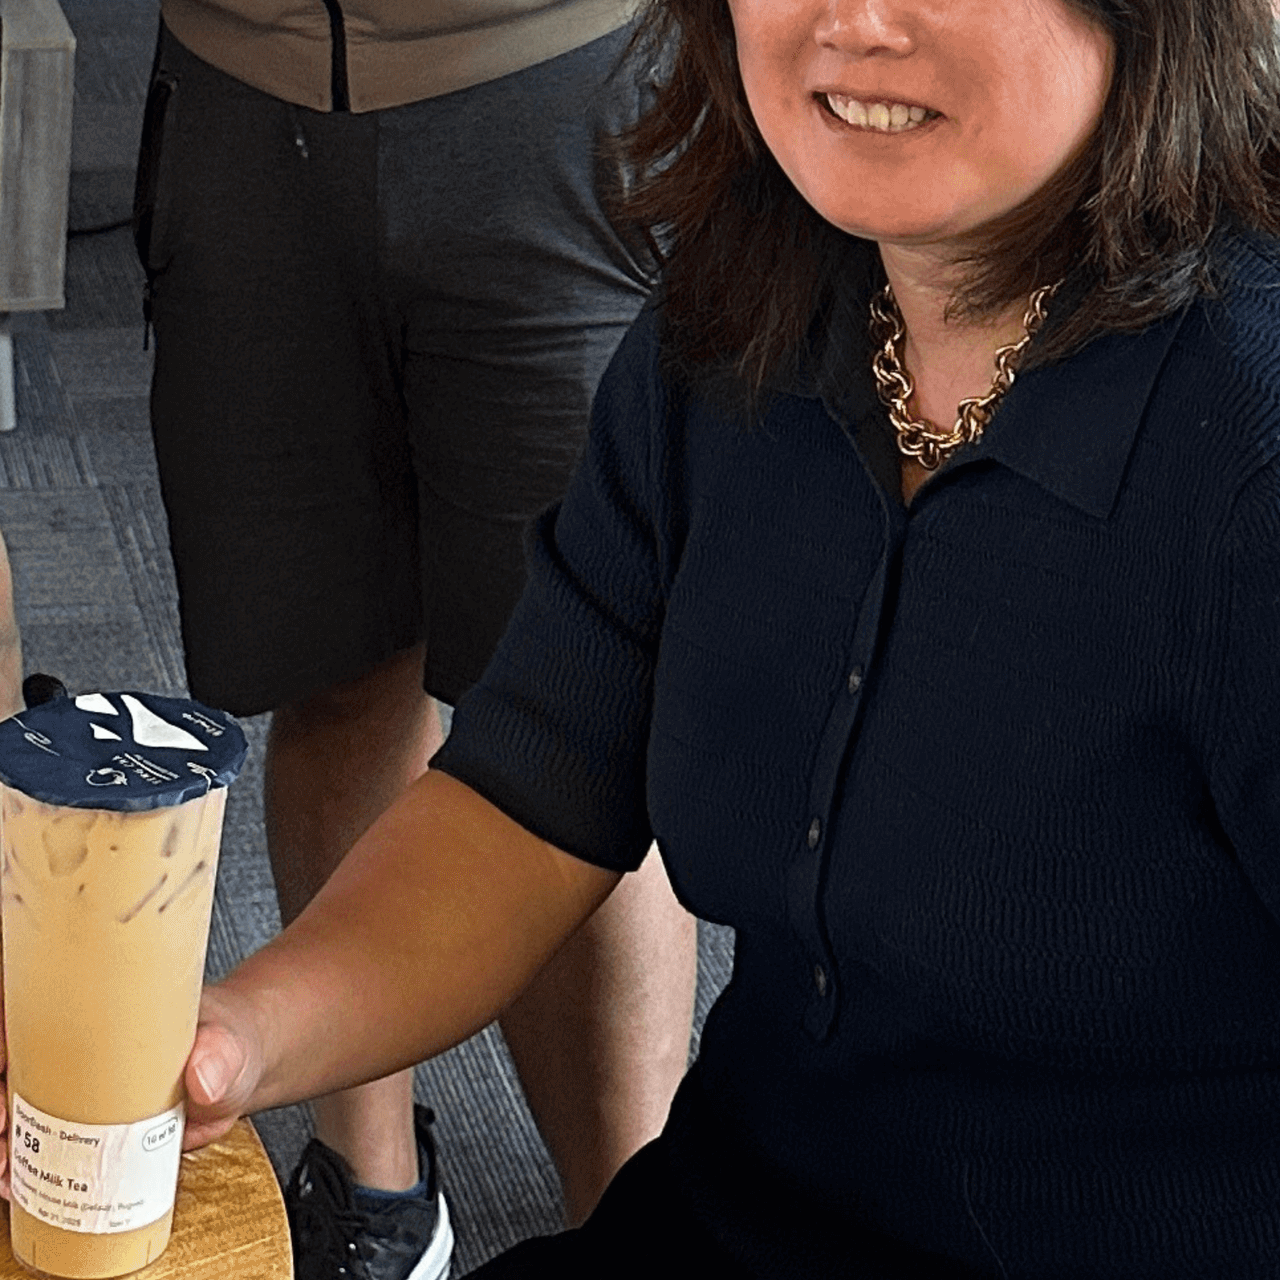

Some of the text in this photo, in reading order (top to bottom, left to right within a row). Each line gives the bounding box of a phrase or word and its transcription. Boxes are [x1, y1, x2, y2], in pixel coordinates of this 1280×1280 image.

[23, 1130, 40, 1154] 58
[59, 1129, 100, 1148] Delivery
[39, 1168, 64, 1188] Milk
[67, 1177, 89, 1193] Tea
